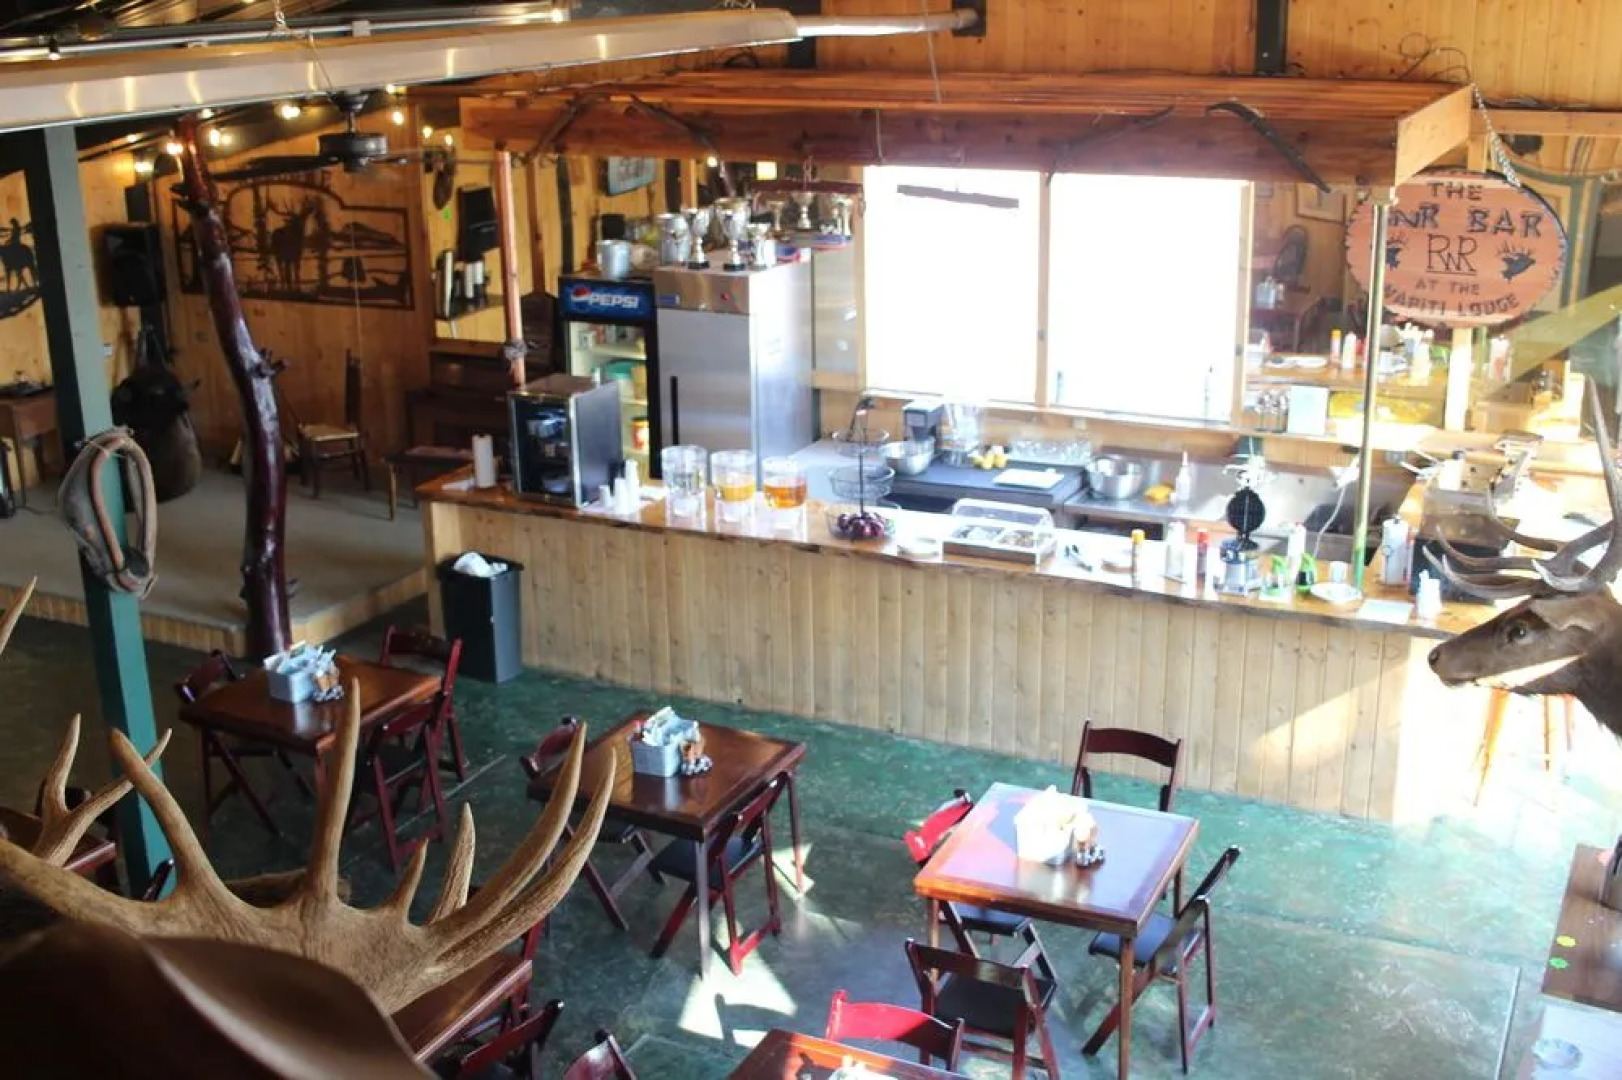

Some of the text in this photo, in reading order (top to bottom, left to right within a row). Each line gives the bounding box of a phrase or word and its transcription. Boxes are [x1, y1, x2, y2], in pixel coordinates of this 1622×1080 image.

[1427, 182, 1483, 201] THE
[1387, 202, 1544, 238] NR BAR
[1415, 278, 1480, 296] AT THE
[588, 292, 639, 309] PEPSI
[1457, 293, 1520, 317] LODGE
